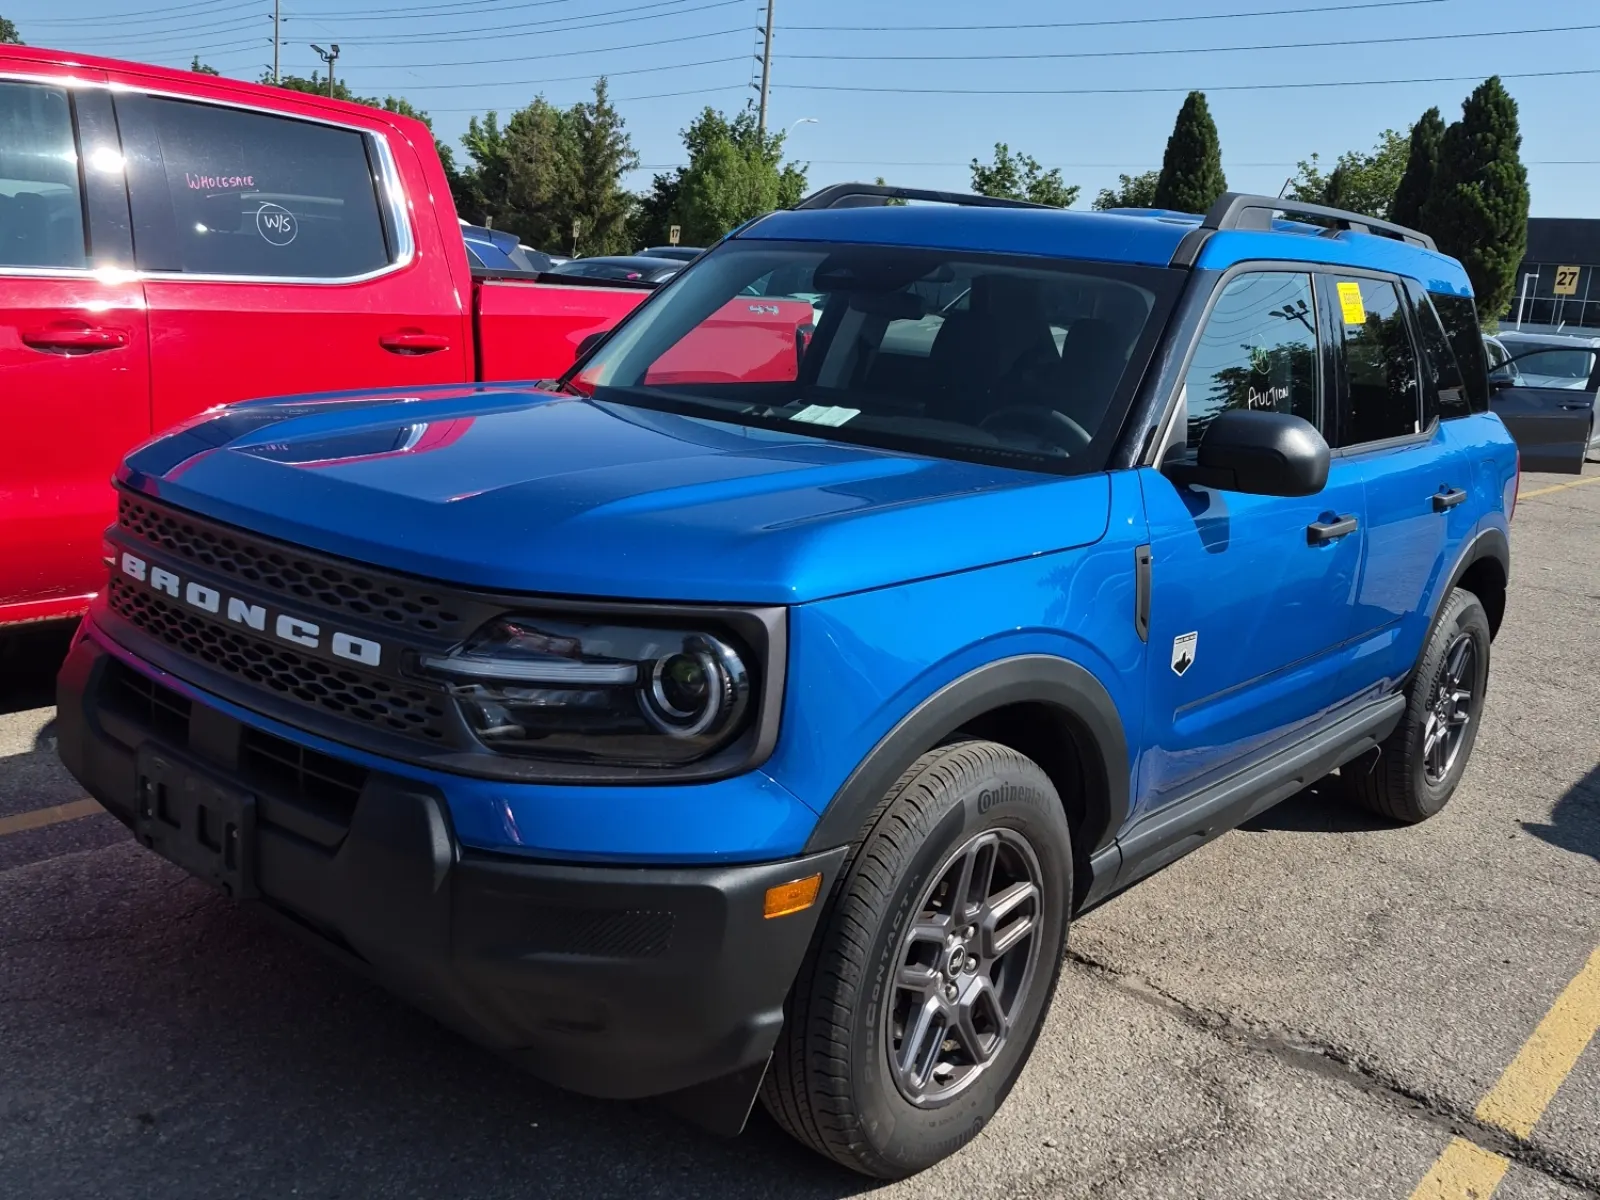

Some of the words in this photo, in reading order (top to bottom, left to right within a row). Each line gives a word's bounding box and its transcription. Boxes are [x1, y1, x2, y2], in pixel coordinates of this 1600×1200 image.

[671, 229, 680, 239] 17
[1557, 271, 1578, 287] 27
[1248, 385, 1289, 412] AUCTION
[121, 551, 382, 667] BRONCO
[977, 781, 1046, 815] Continental
